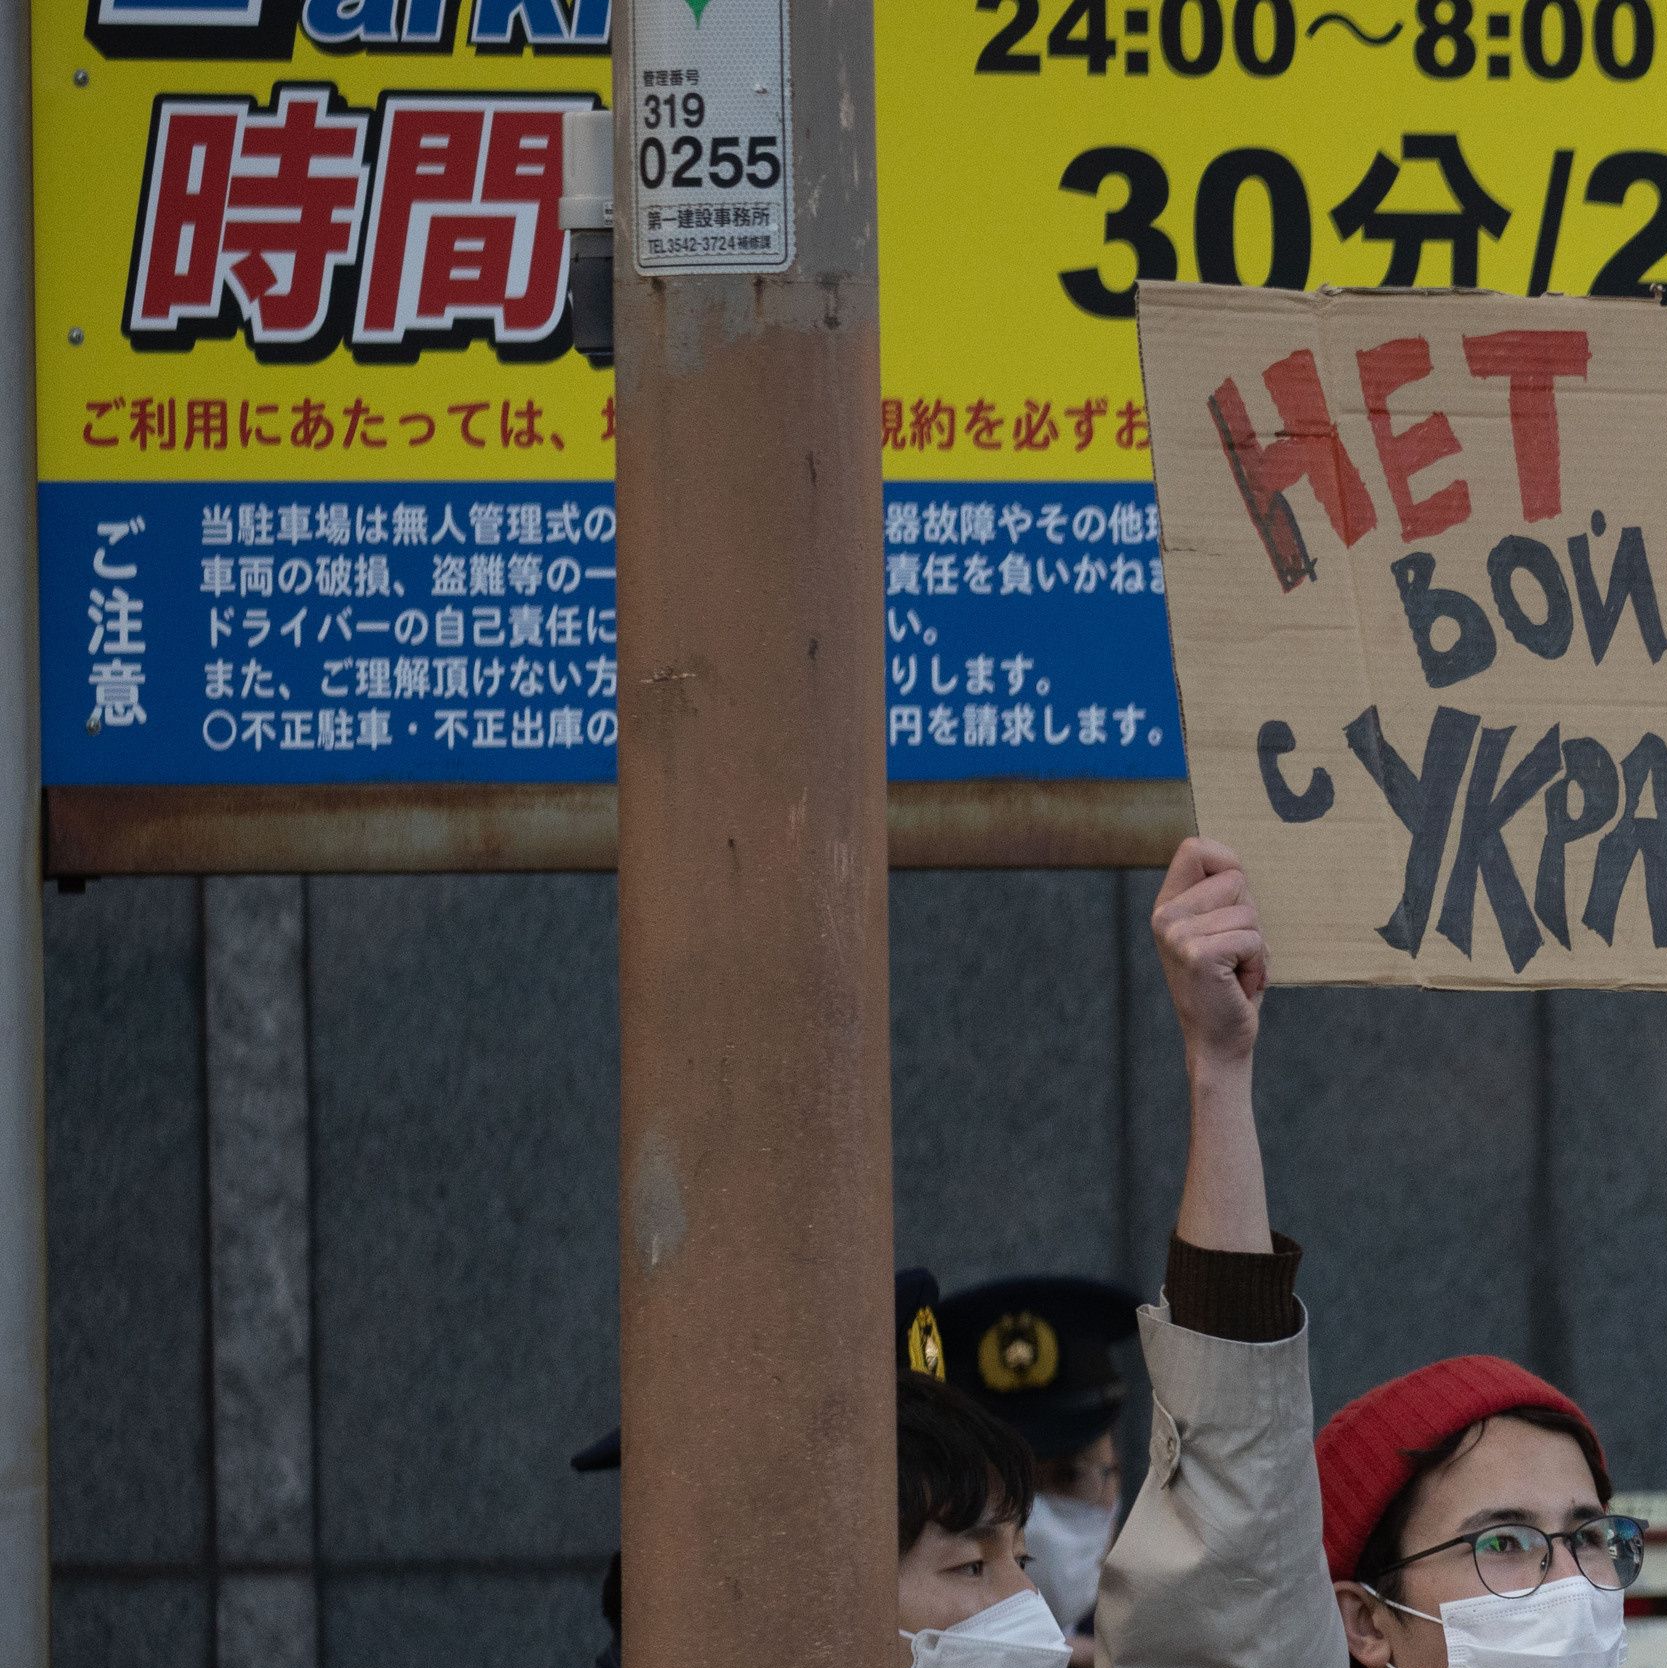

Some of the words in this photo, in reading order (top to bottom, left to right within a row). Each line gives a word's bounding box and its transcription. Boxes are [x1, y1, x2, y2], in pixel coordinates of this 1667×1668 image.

[643, 69, 699, 87] 管理番号
[643, 92, 705, 130] 319
[639, 135, 781, 190] 0255
[648, 207, 771, 231] 第一建設事務所
[1207, 330, 1593, 594] НЕТ
[86, 514, 148, 726] ご注意
